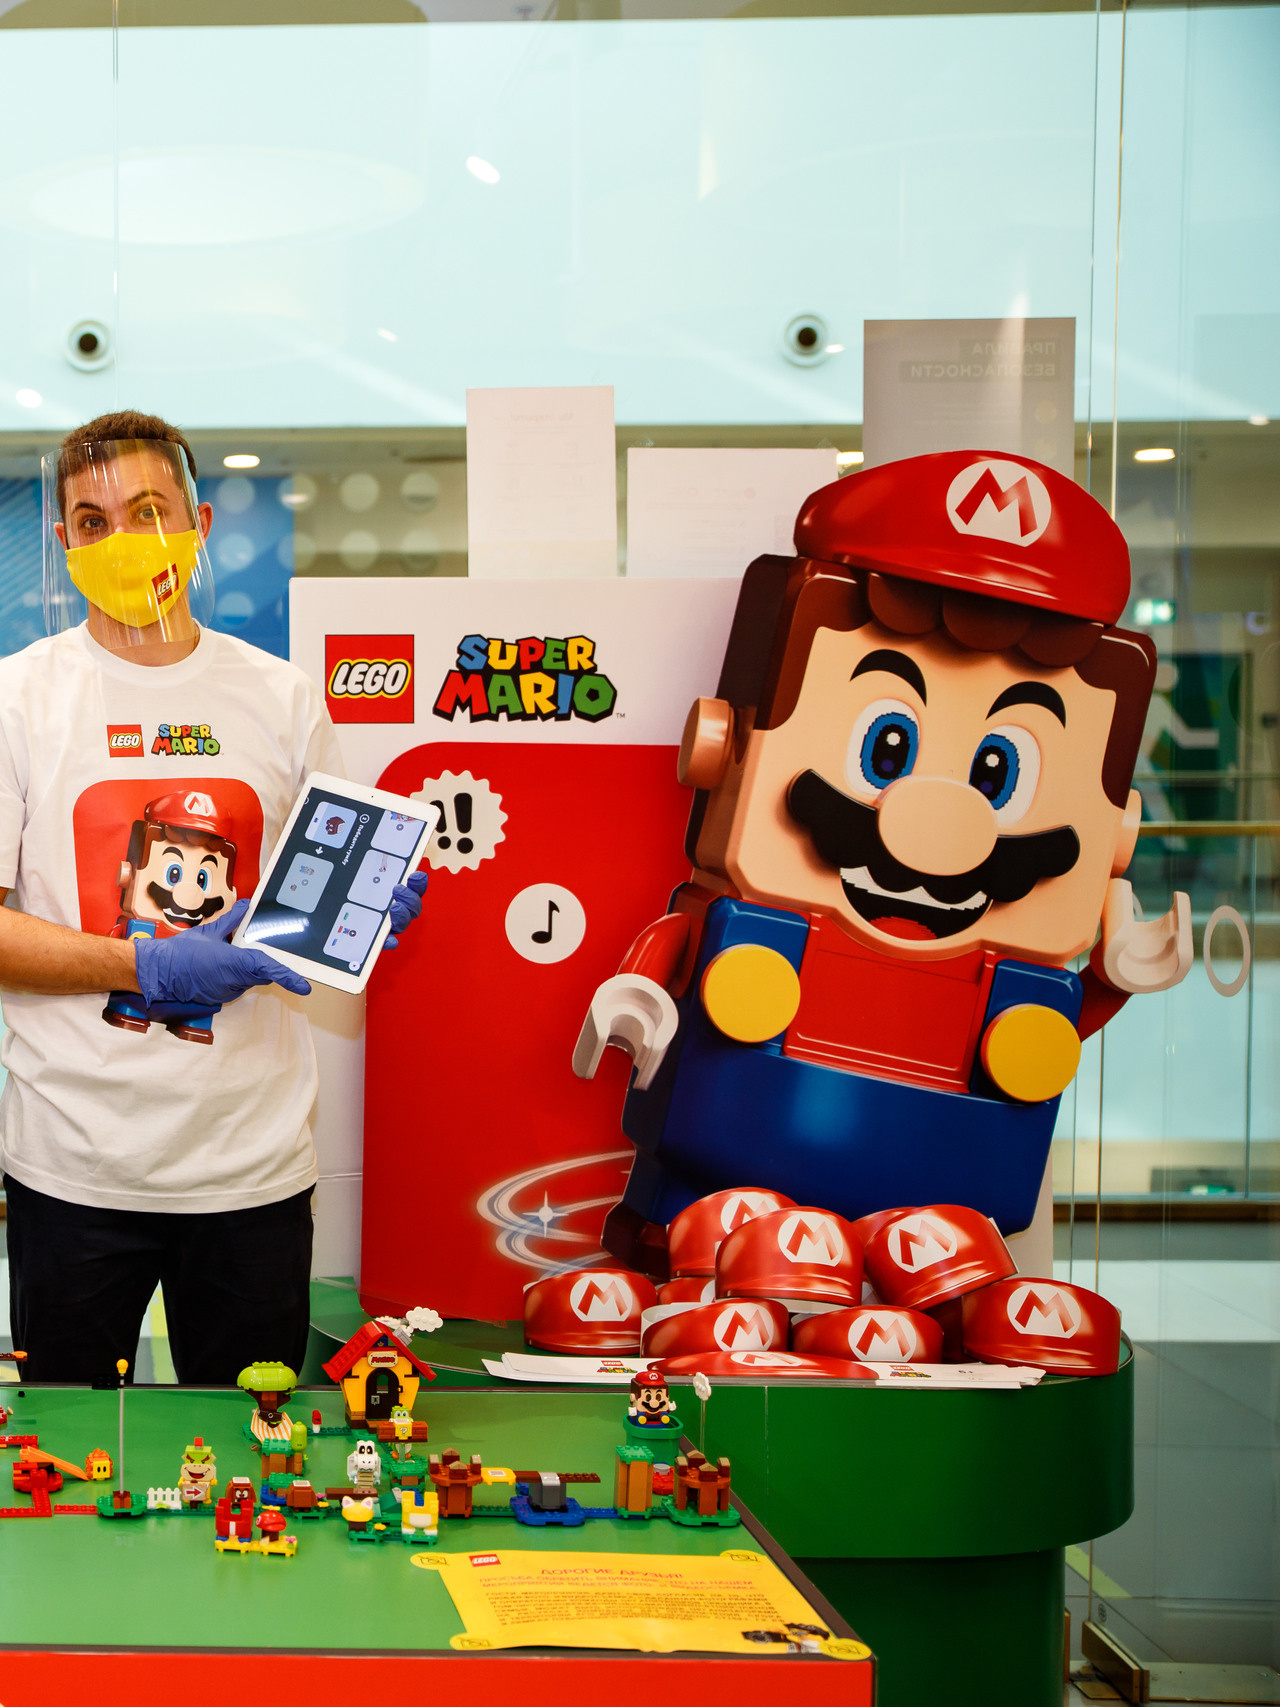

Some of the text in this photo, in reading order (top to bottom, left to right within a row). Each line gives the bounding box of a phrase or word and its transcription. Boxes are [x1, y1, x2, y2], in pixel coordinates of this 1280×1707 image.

[156, 572, 179, 600] LEGO
[456, 633, 597, 673] SUPER
[328, 658, 412, 699] LEGO
[432, 669, 618, 724] MARIO
[158, 723, 212, 738] SUPER
[110, 733, 142, 748] LEGO
[151, 736, 221, 757] MARIO
[370, 1356, 396, 1364] MARIO
[472, 1556, 498, 1565] LEGO
[541, 1568, 614, 1576] ДОРОГИЕ
